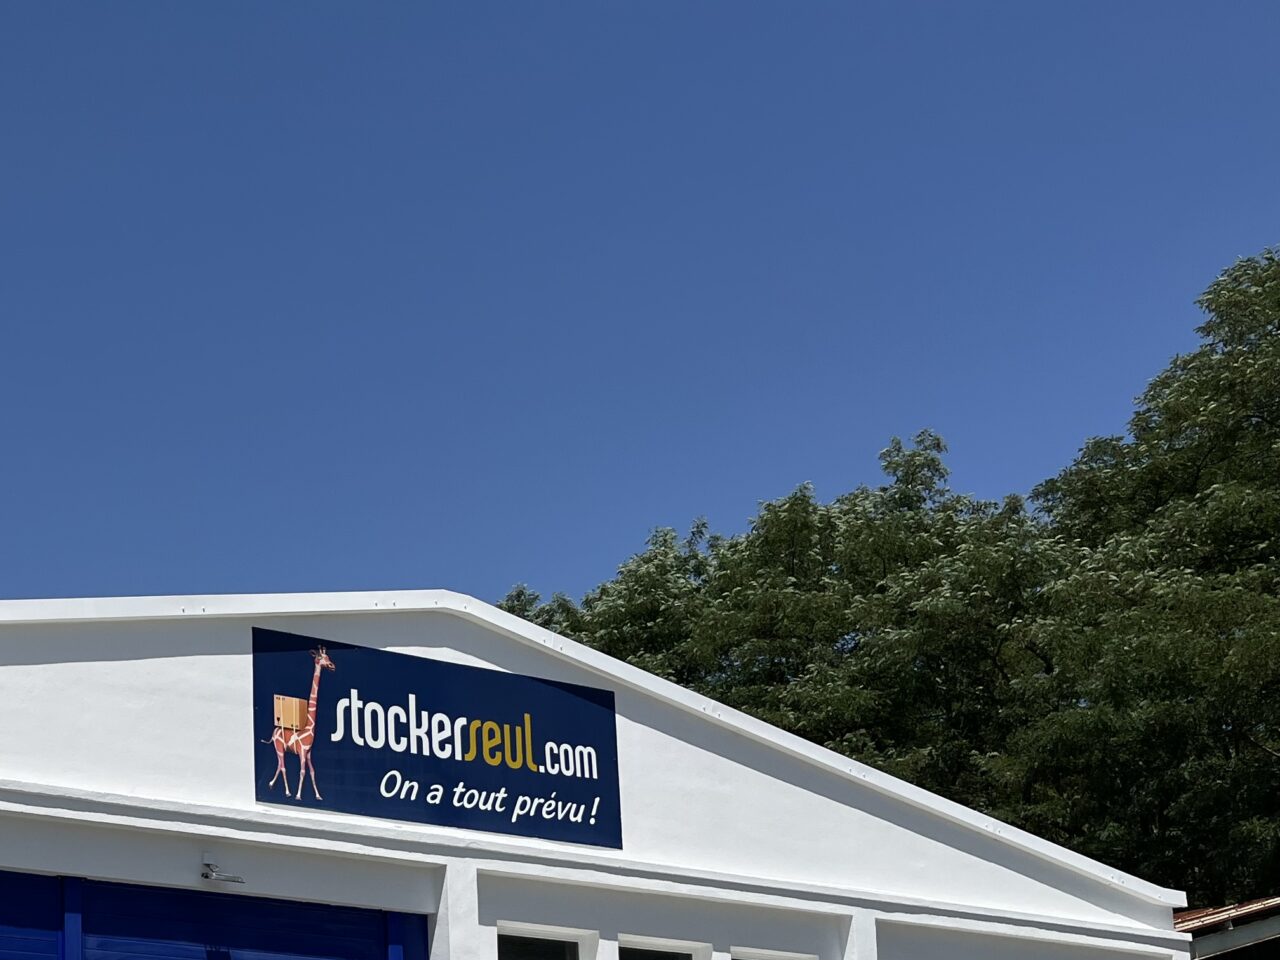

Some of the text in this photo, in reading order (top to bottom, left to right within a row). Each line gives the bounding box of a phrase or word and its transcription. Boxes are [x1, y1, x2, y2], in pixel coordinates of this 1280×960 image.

[330, 688, 598, 779] stockerseul.com
[379, 769, 417, 800] On
[426, 784, 444, 804] a
[452, 781, 507, 813] tout
